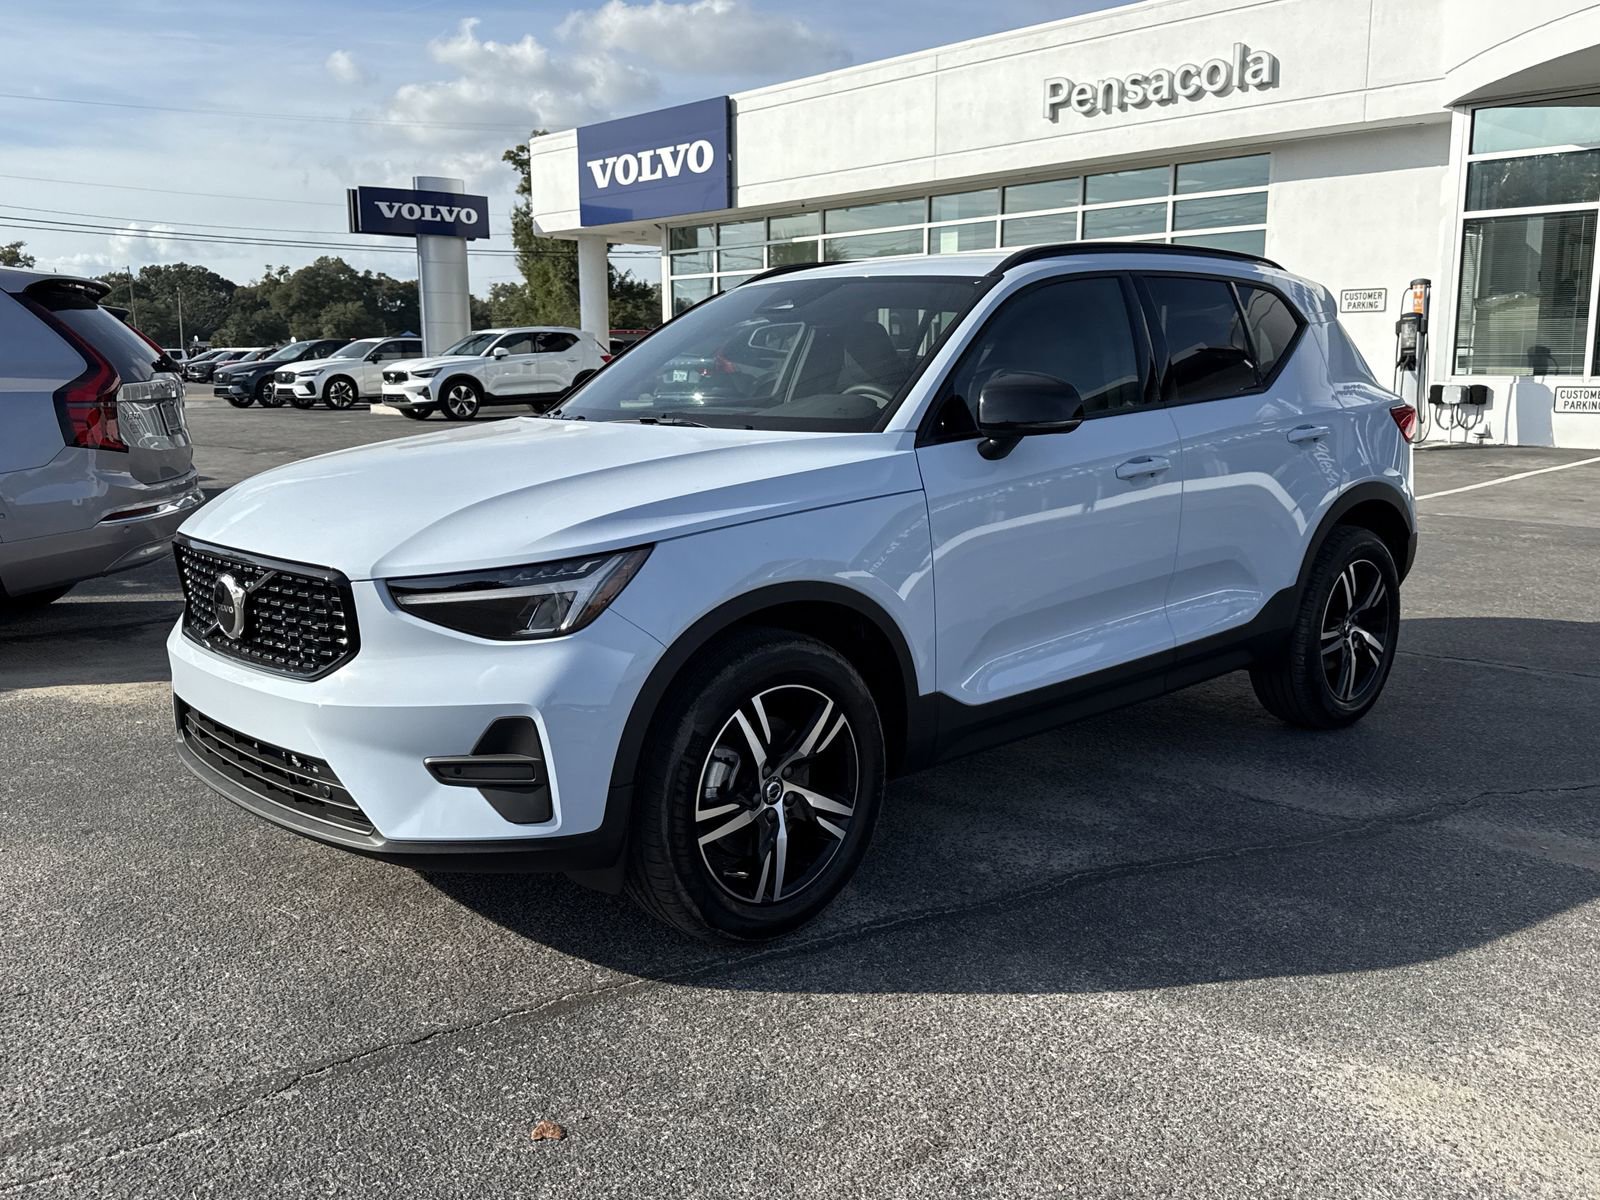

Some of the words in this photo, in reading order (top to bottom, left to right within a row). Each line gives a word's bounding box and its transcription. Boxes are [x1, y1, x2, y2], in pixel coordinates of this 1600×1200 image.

[1043, 42, 1279, 123] Pensacola
[587, 140, 714, 188] VOLVO
[374, 201, 478, 224] VOLVO
[1344, 291, 1383, 301] CUSTOMER
[1347, 301, 1379, 310] PARKING
